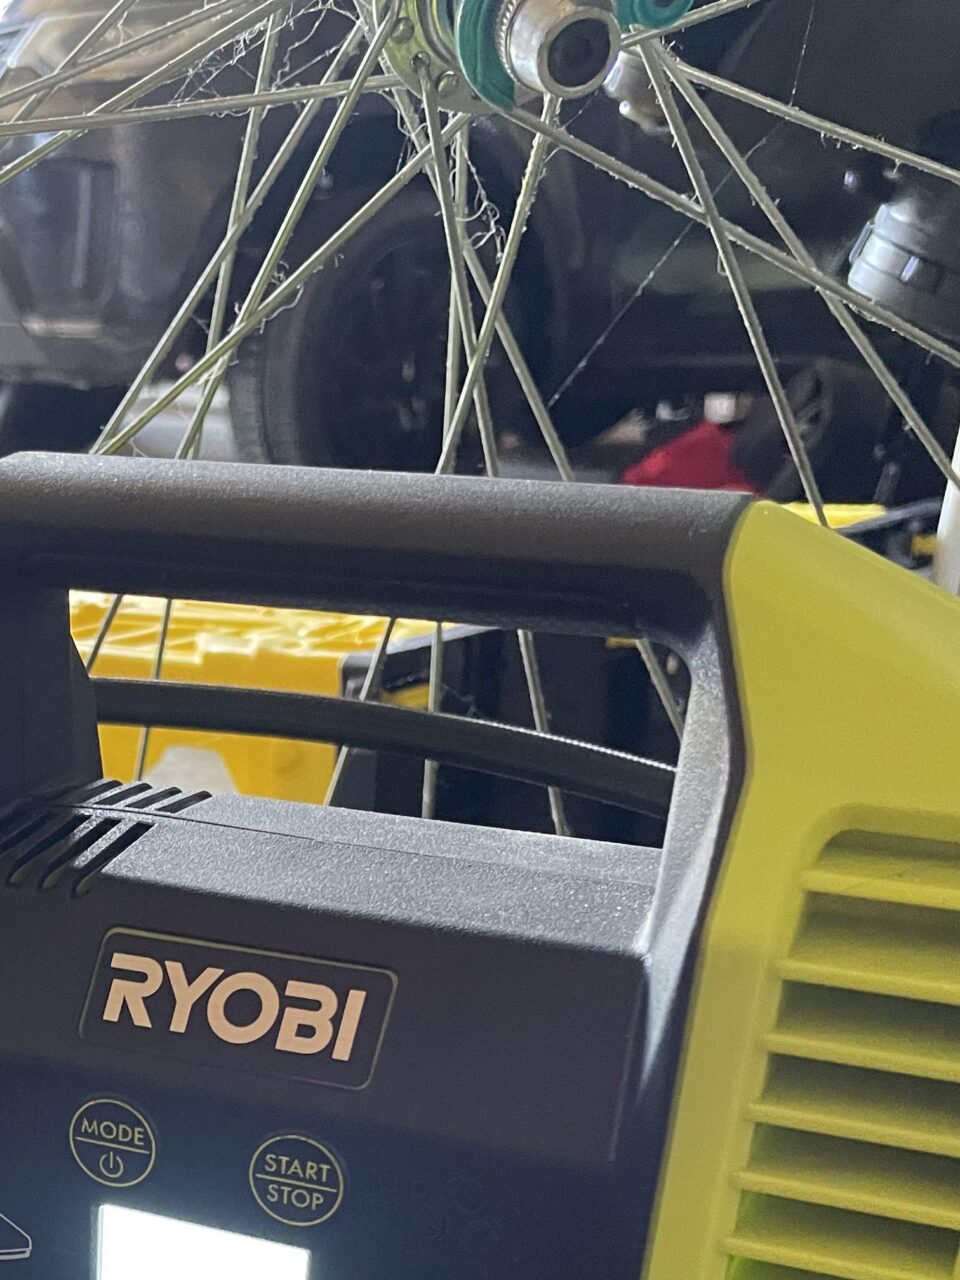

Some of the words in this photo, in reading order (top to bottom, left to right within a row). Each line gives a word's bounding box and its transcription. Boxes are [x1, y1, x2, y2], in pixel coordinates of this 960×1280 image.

[103, 953, 367, 1061] RYOBI
[81, 1117, 145, 1146] MODE
[264, 1154, 331, 1183] START
[266, 1184, 325, 1211] STOP
